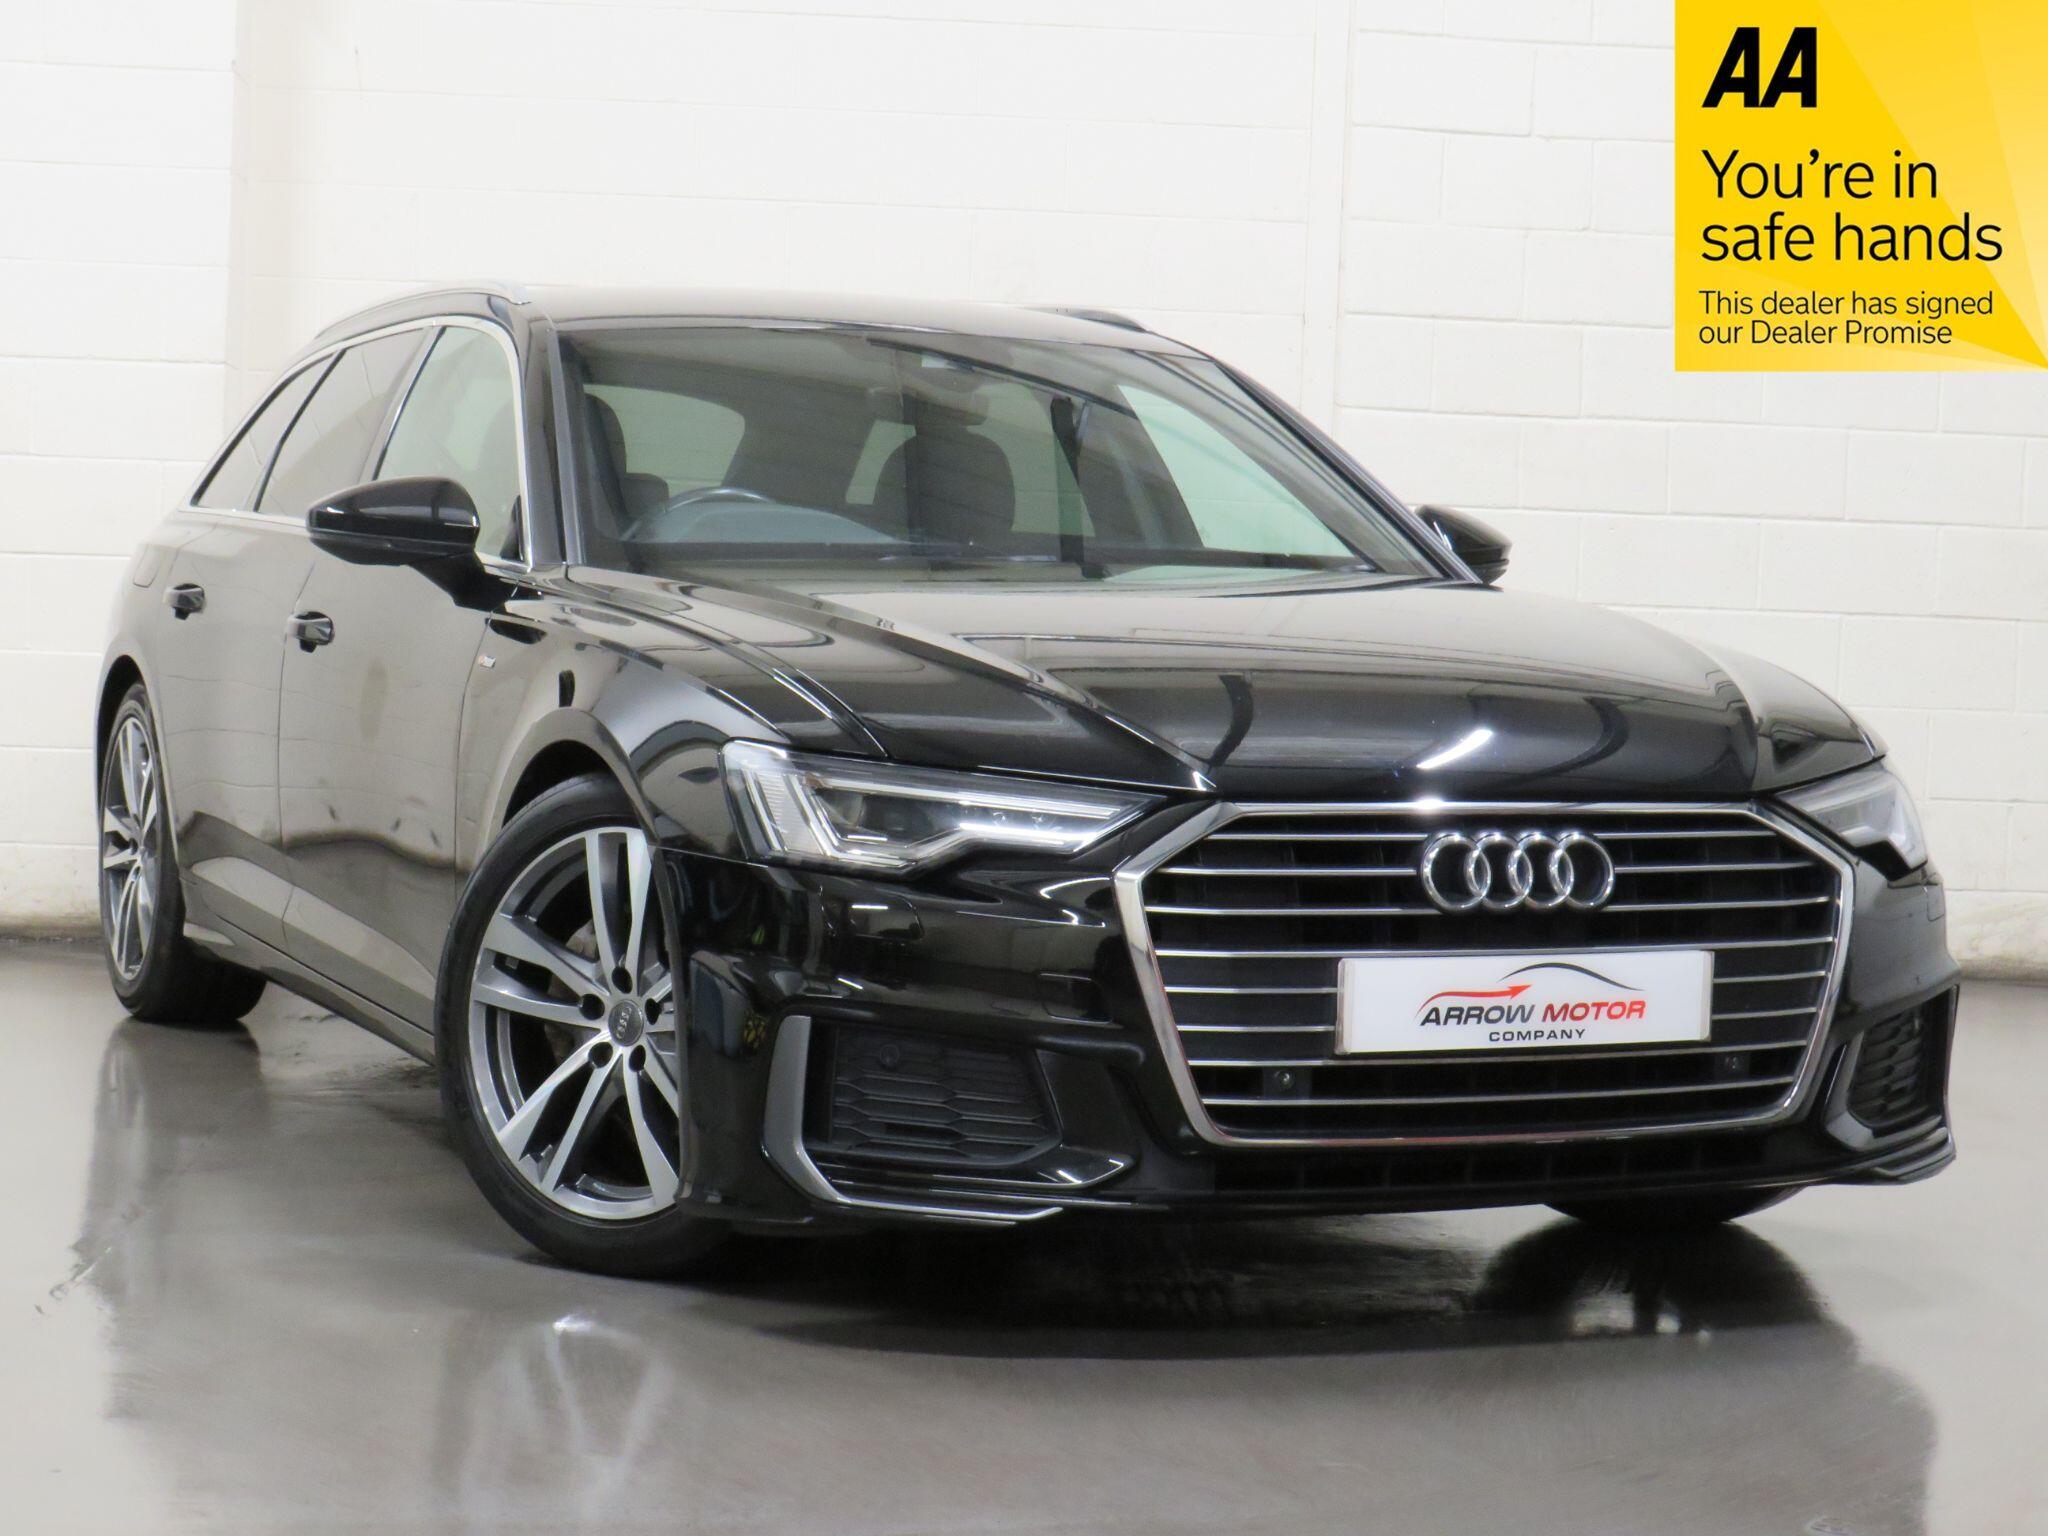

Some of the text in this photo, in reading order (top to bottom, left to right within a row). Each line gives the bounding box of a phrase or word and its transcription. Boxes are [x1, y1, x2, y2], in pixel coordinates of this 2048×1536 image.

[1420, 1000, 1646, 1026] ARROW MOTOR
[1489, 1028, 1586, 1042] COMPANY
